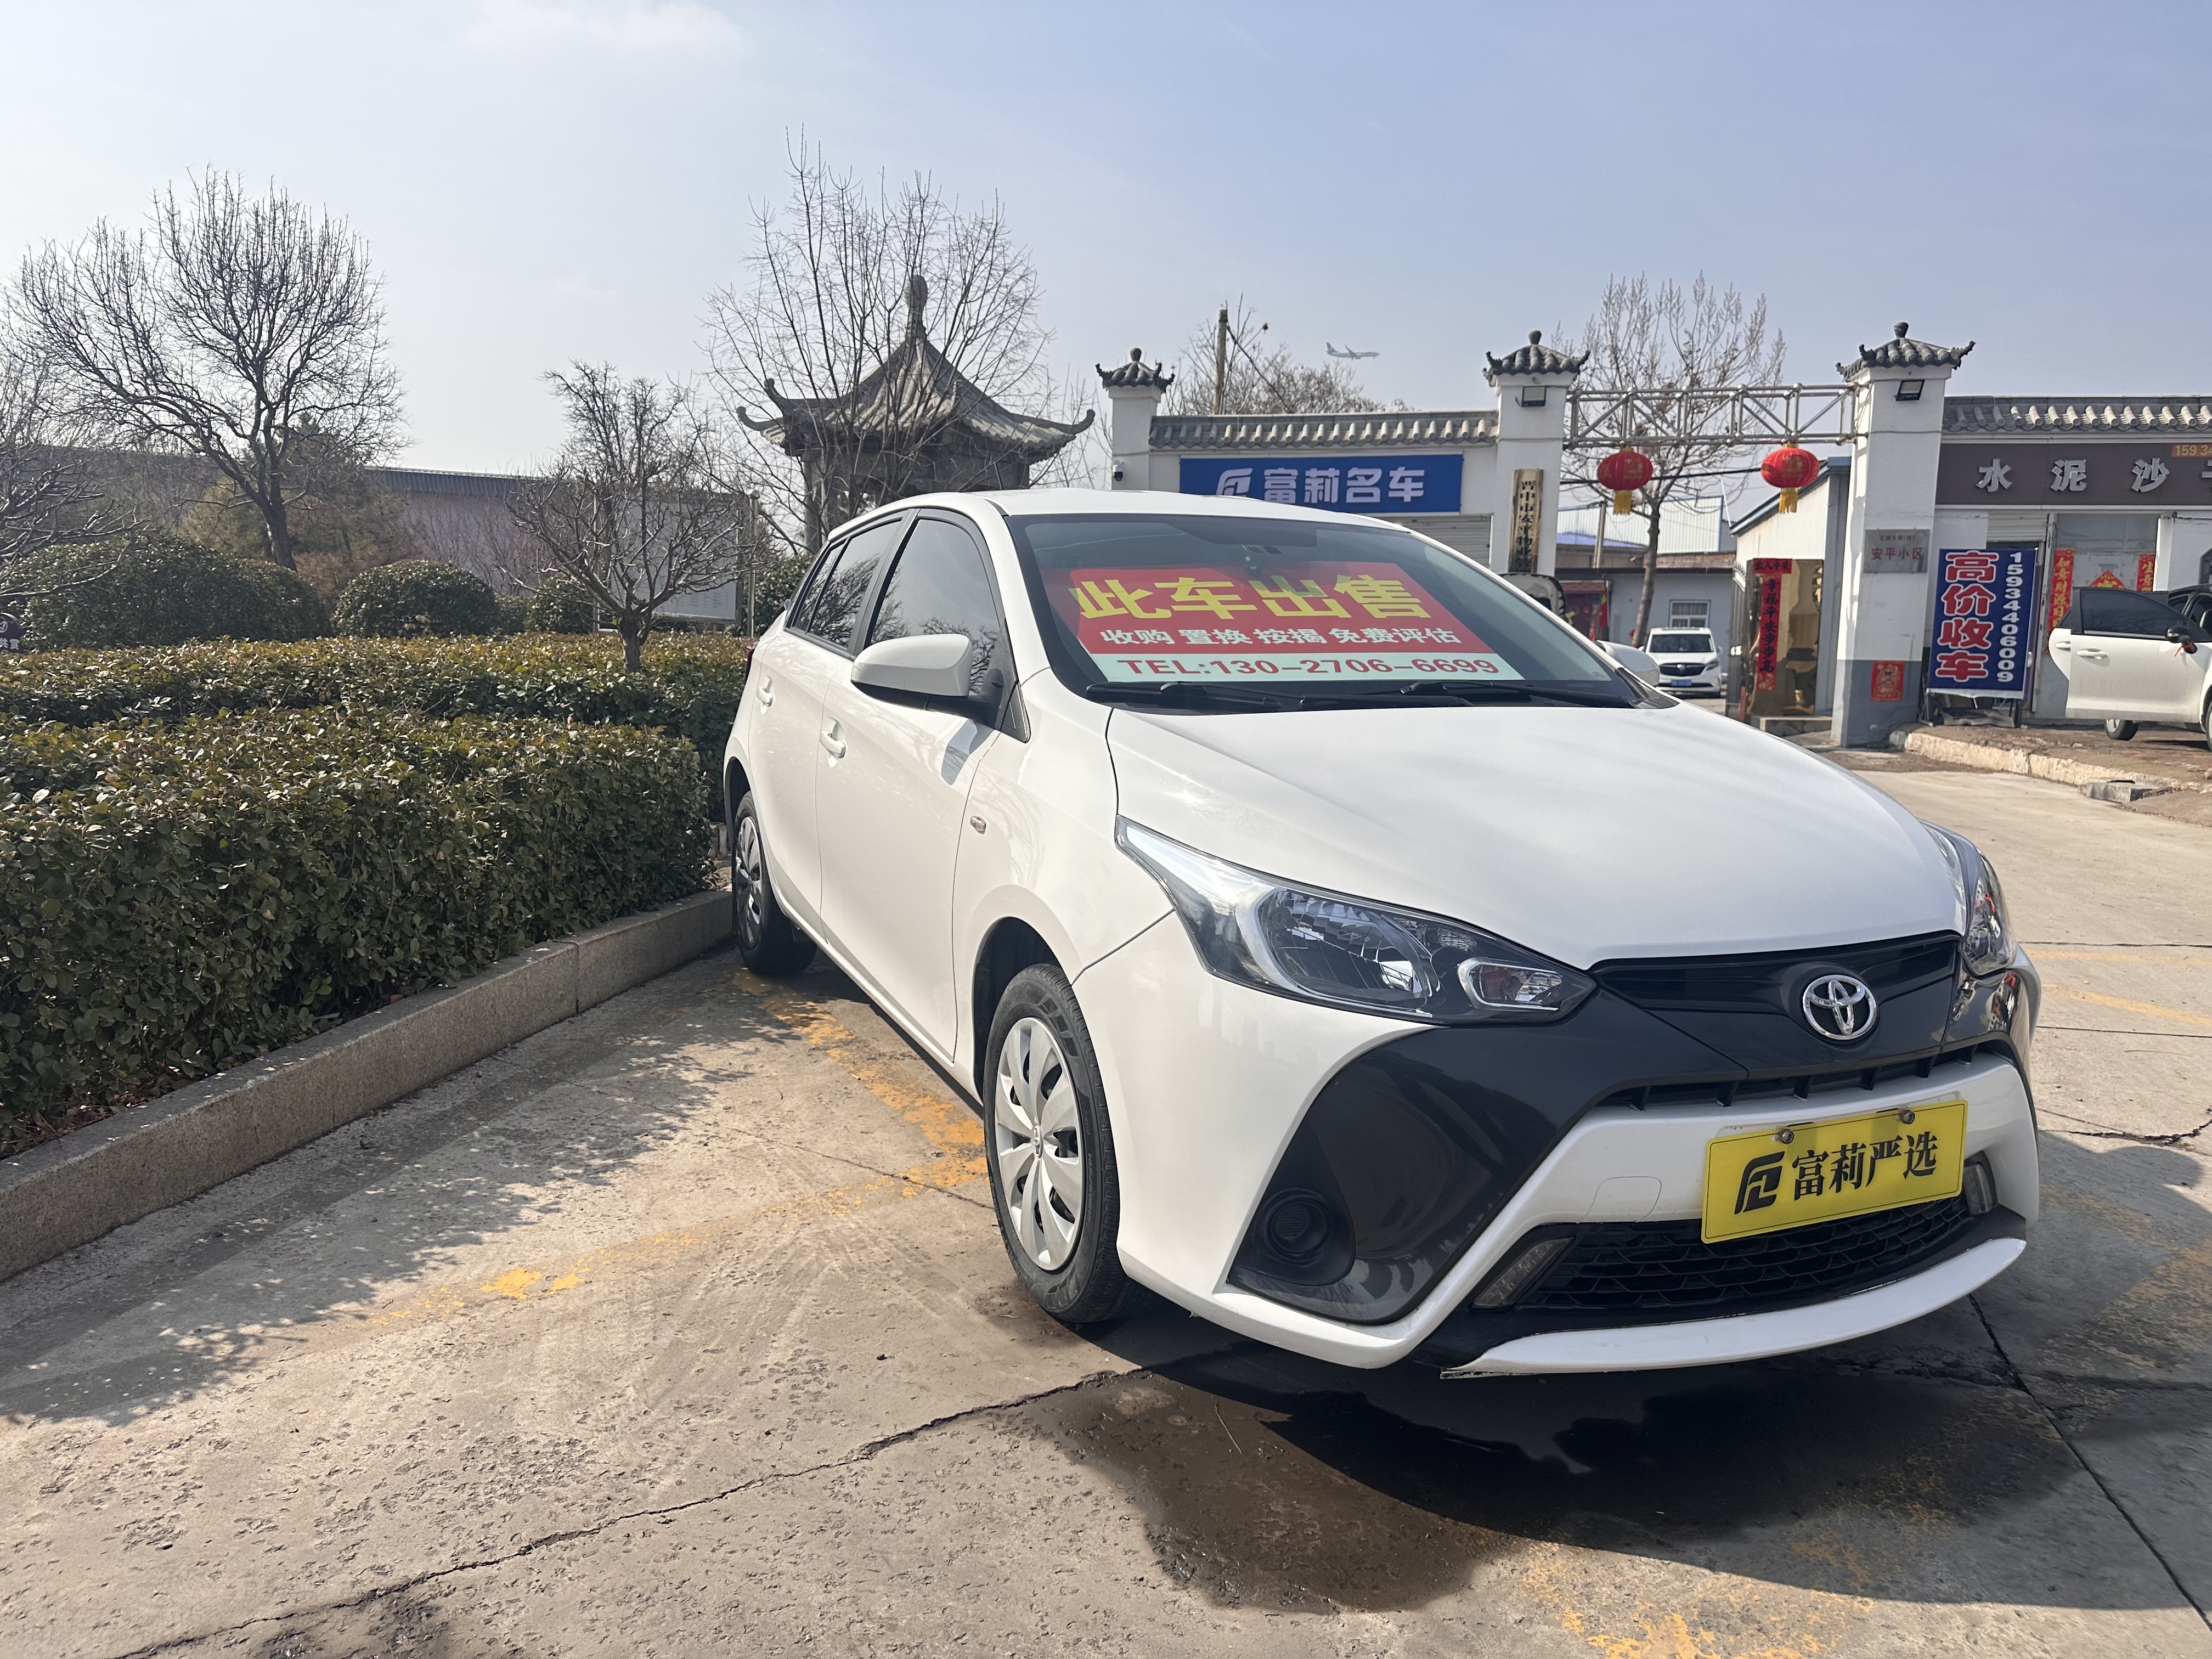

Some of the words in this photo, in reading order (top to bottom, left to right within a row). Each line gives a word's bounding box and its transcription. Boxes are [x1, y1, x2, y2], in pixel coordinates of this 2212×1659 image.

[2175, 445, 2196, 456] 159
[1264, 466, 1425, 504] 富莉名车
[1976, 458, 2212, 493] 水泥沙
[1871, 548, 1923, 560] 安平小区
[1068, 574, 1431, 619] 此车出售
[1936, 550, 1999, 682] 高价收车
[1996, 552, 2023, 682] 15934406009
[1099, 629, 1175, 644] 收购
[1178, 629, 1253, 644] 置换
[1253, 628, 1328, 644] 按揭
[1328, 628, 1462, 644] 免费评估
[1759, 579, 1780, 673] 幸福平安步步高
[1792, 1131, 1939, 1201] 富莉严选
